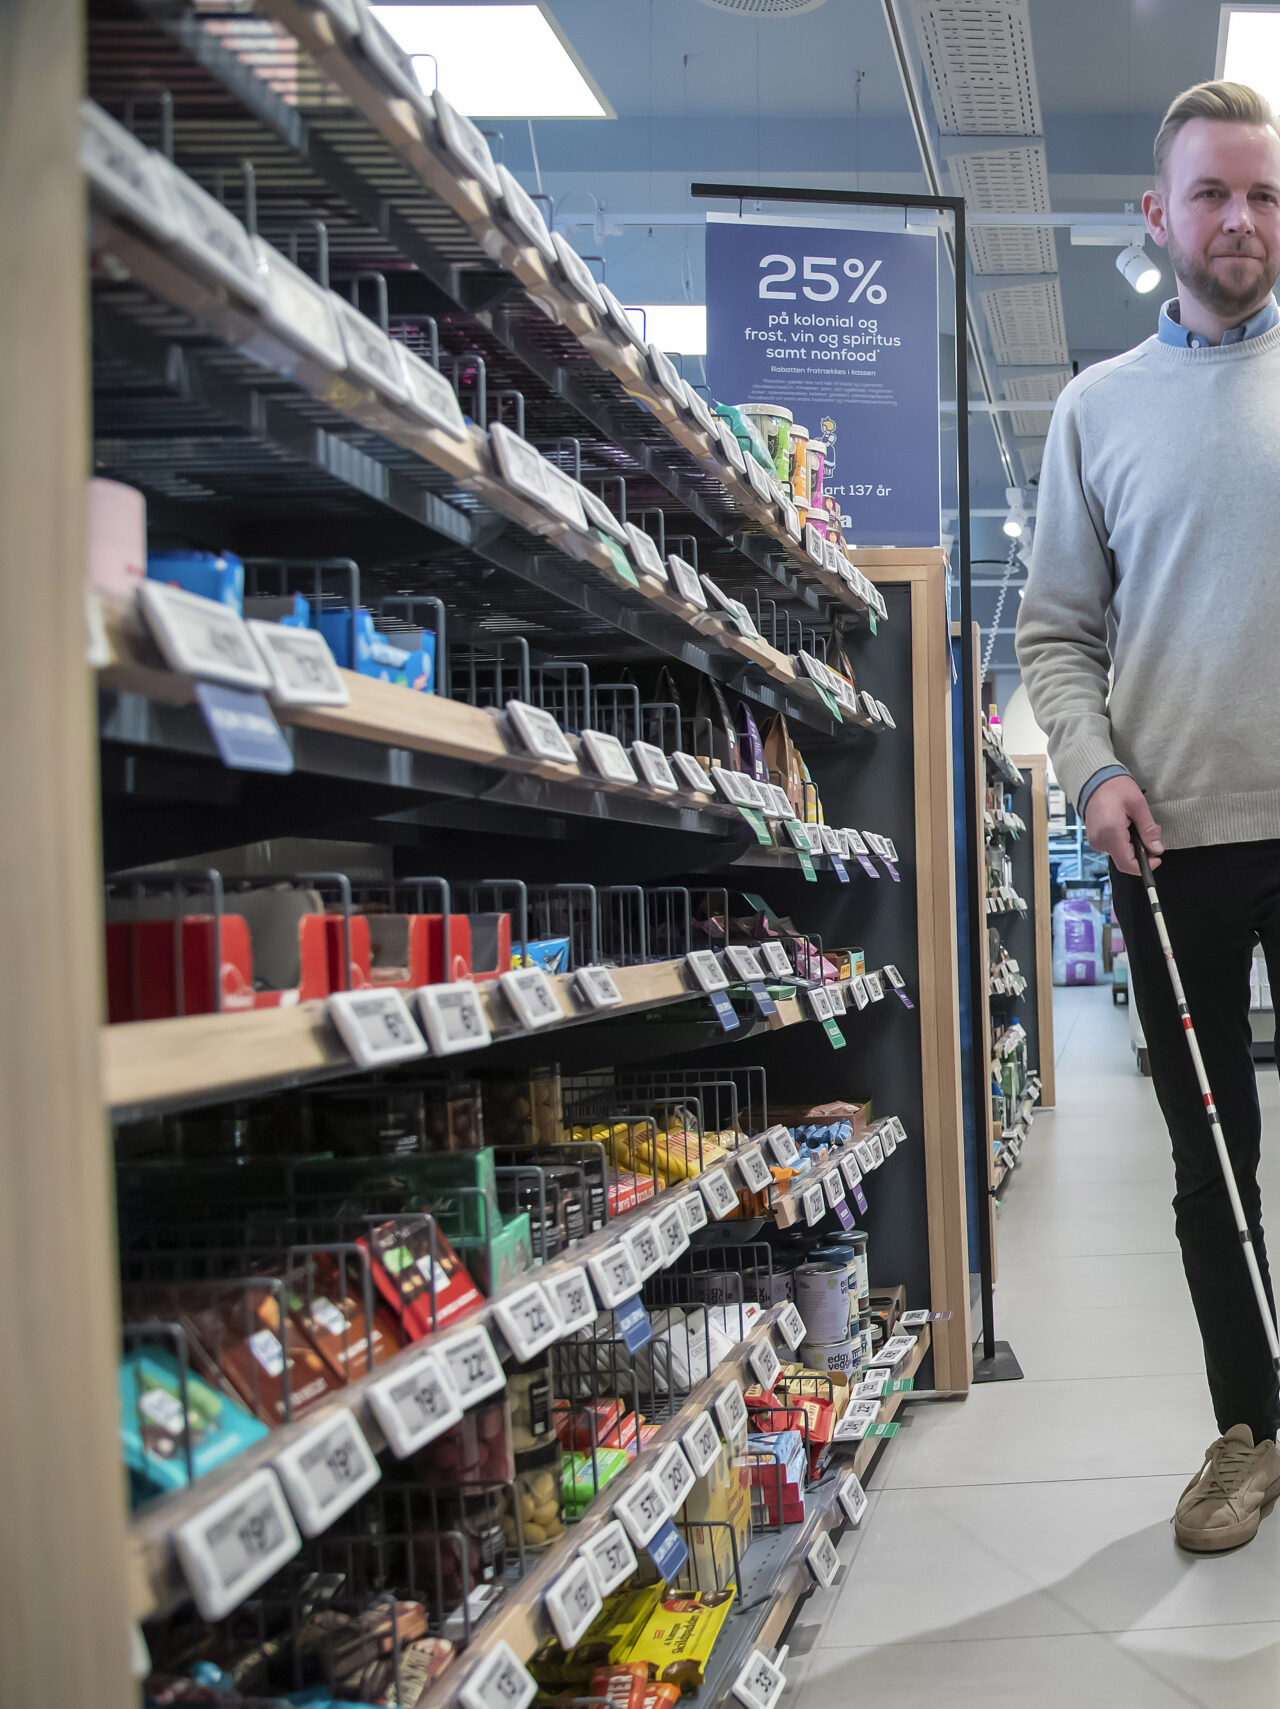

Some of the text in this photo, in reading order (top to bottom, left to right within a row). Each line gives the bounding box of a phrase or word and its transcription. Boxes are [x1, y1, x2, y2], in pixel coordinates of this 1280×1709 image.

[758, 253, 888, 305] 25%
[768, 312, 878, 334] på kolonial og
[745, 327, 901, 349] frost, vin og spiritus
[766, 348, 807, 359] samt
[770, 365, 806, 374] Rabatten
[848, 484, 873, 497] 137
[876, 483, 892, 497] år
